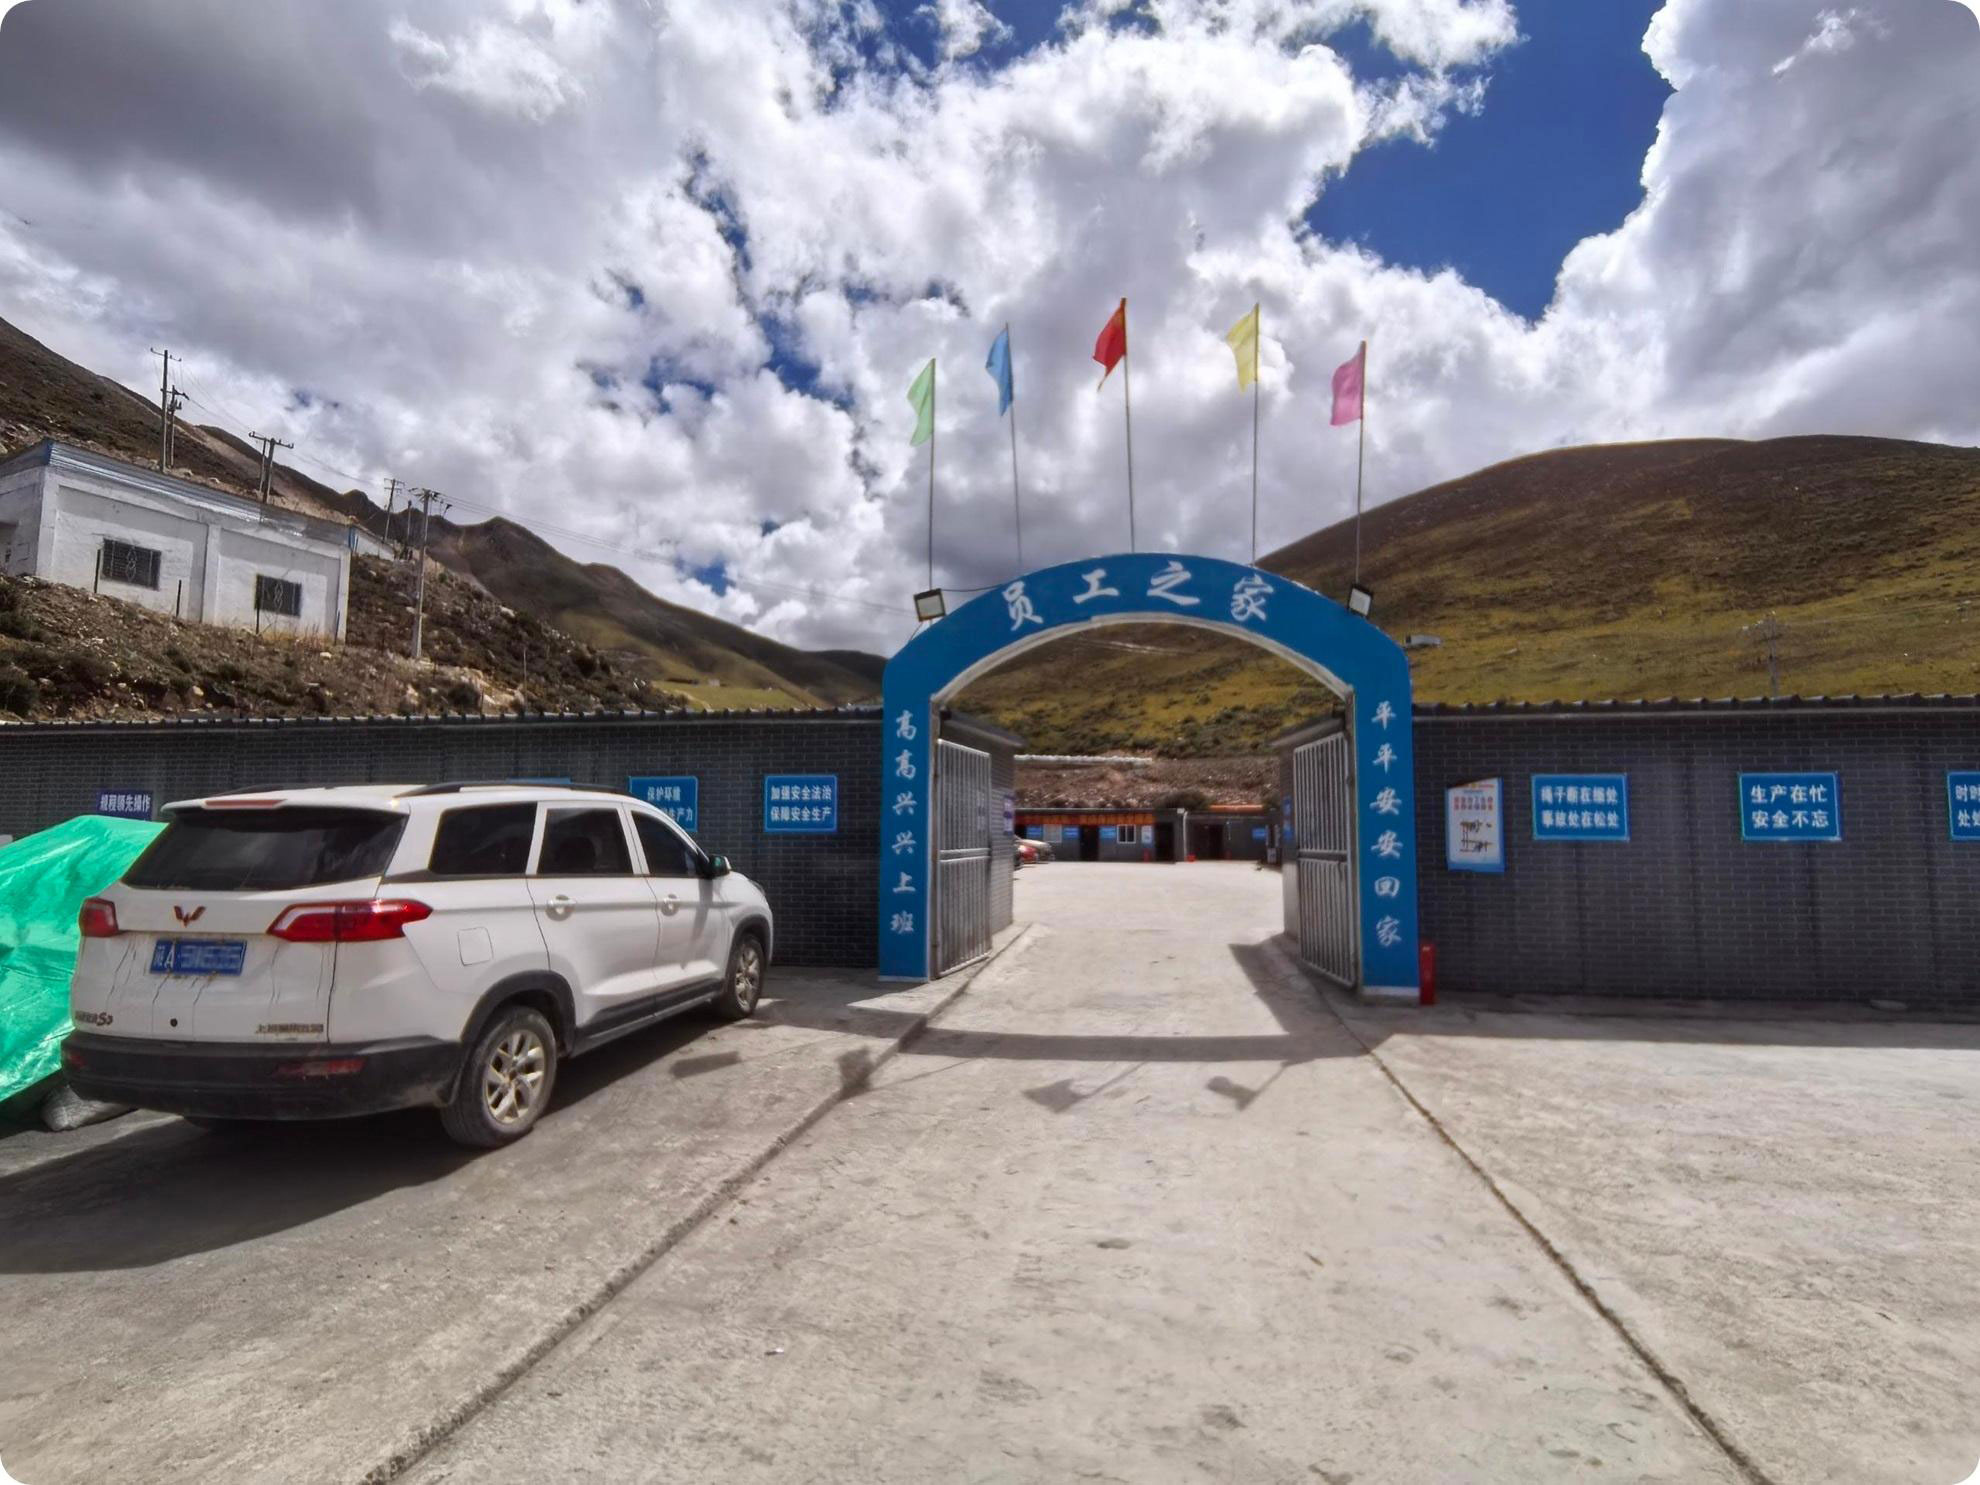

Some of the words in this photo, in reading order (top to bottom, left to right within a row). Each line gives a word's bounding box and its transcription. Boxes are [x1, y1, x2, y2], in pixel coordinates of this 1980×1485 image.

[1002, 560, 1274, 631] 员工之家
[771, 806, 832, 822] 保障安全生产
[890, 710, 918, 934] 高高兴兴上班
[1369, 700, 1403, 946] 平平安安回家
[1752, 810, 1830, 828] 安全不忘
